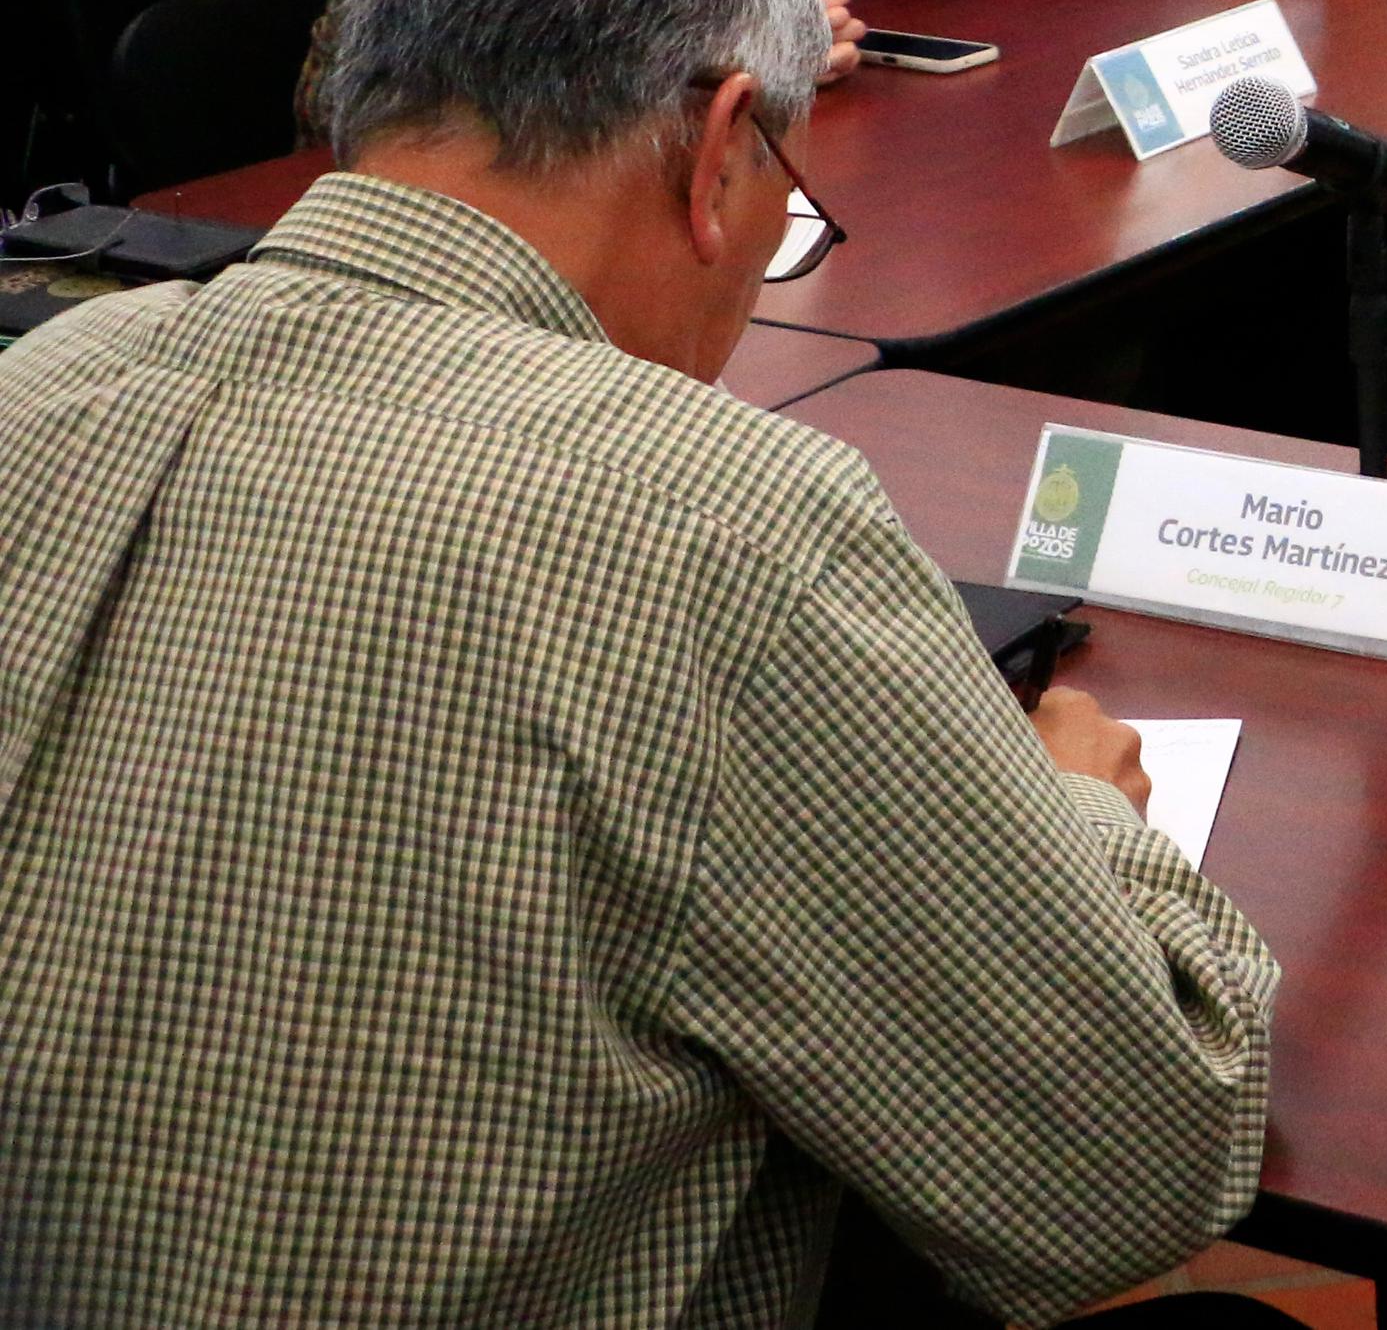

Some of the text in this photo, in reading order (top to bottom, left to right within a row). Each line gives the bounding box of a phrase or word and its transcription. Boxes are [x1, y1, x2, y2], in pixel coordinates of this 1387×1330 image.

[1176, 31, 1261, 71] Sandra Leticia
[1028, 521, 1079, 541] ILLA DE
[1240, 492, 1324, 531] Mario
[1158, 518, 1254, 558] Cortes
[1186, 567, 1346, 611] Concejal Regidor 7
